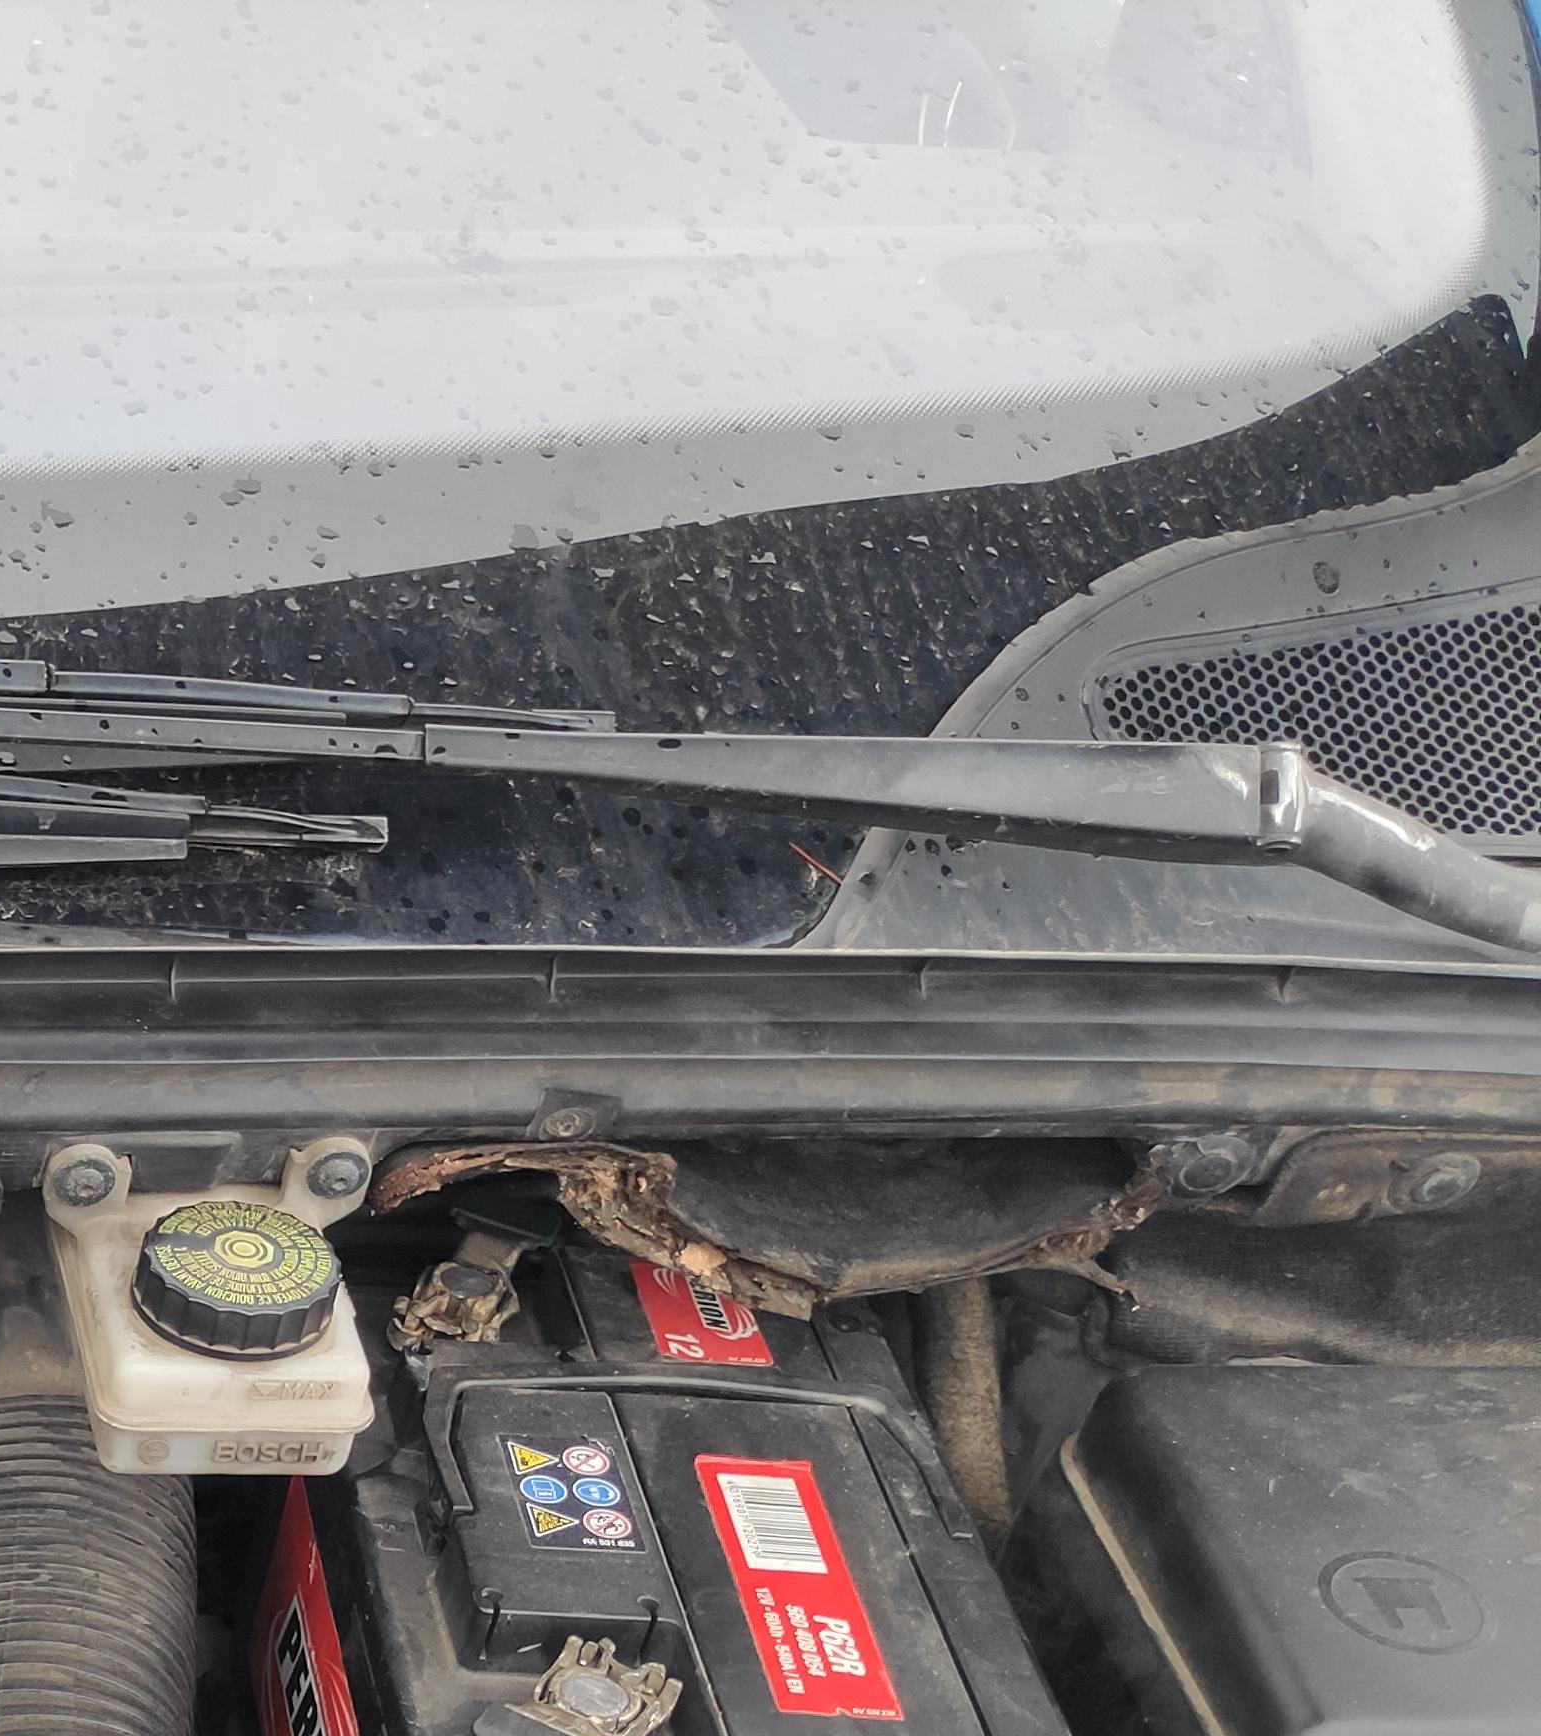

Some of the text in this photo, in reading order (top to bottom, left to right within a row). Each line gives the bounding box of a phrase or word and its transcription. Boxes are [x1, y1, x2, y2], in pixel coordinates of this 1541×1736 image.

[689, 1279, 730, 1331] RION
[281, 1382, 337, 1400] MAX
[213, 1440, 325, 1465] BOSCH
[785, 1604, 810, 1628] 560
[802, 1653, 827, 1677] 054
[812, 1615, 866, 1676] P62R
